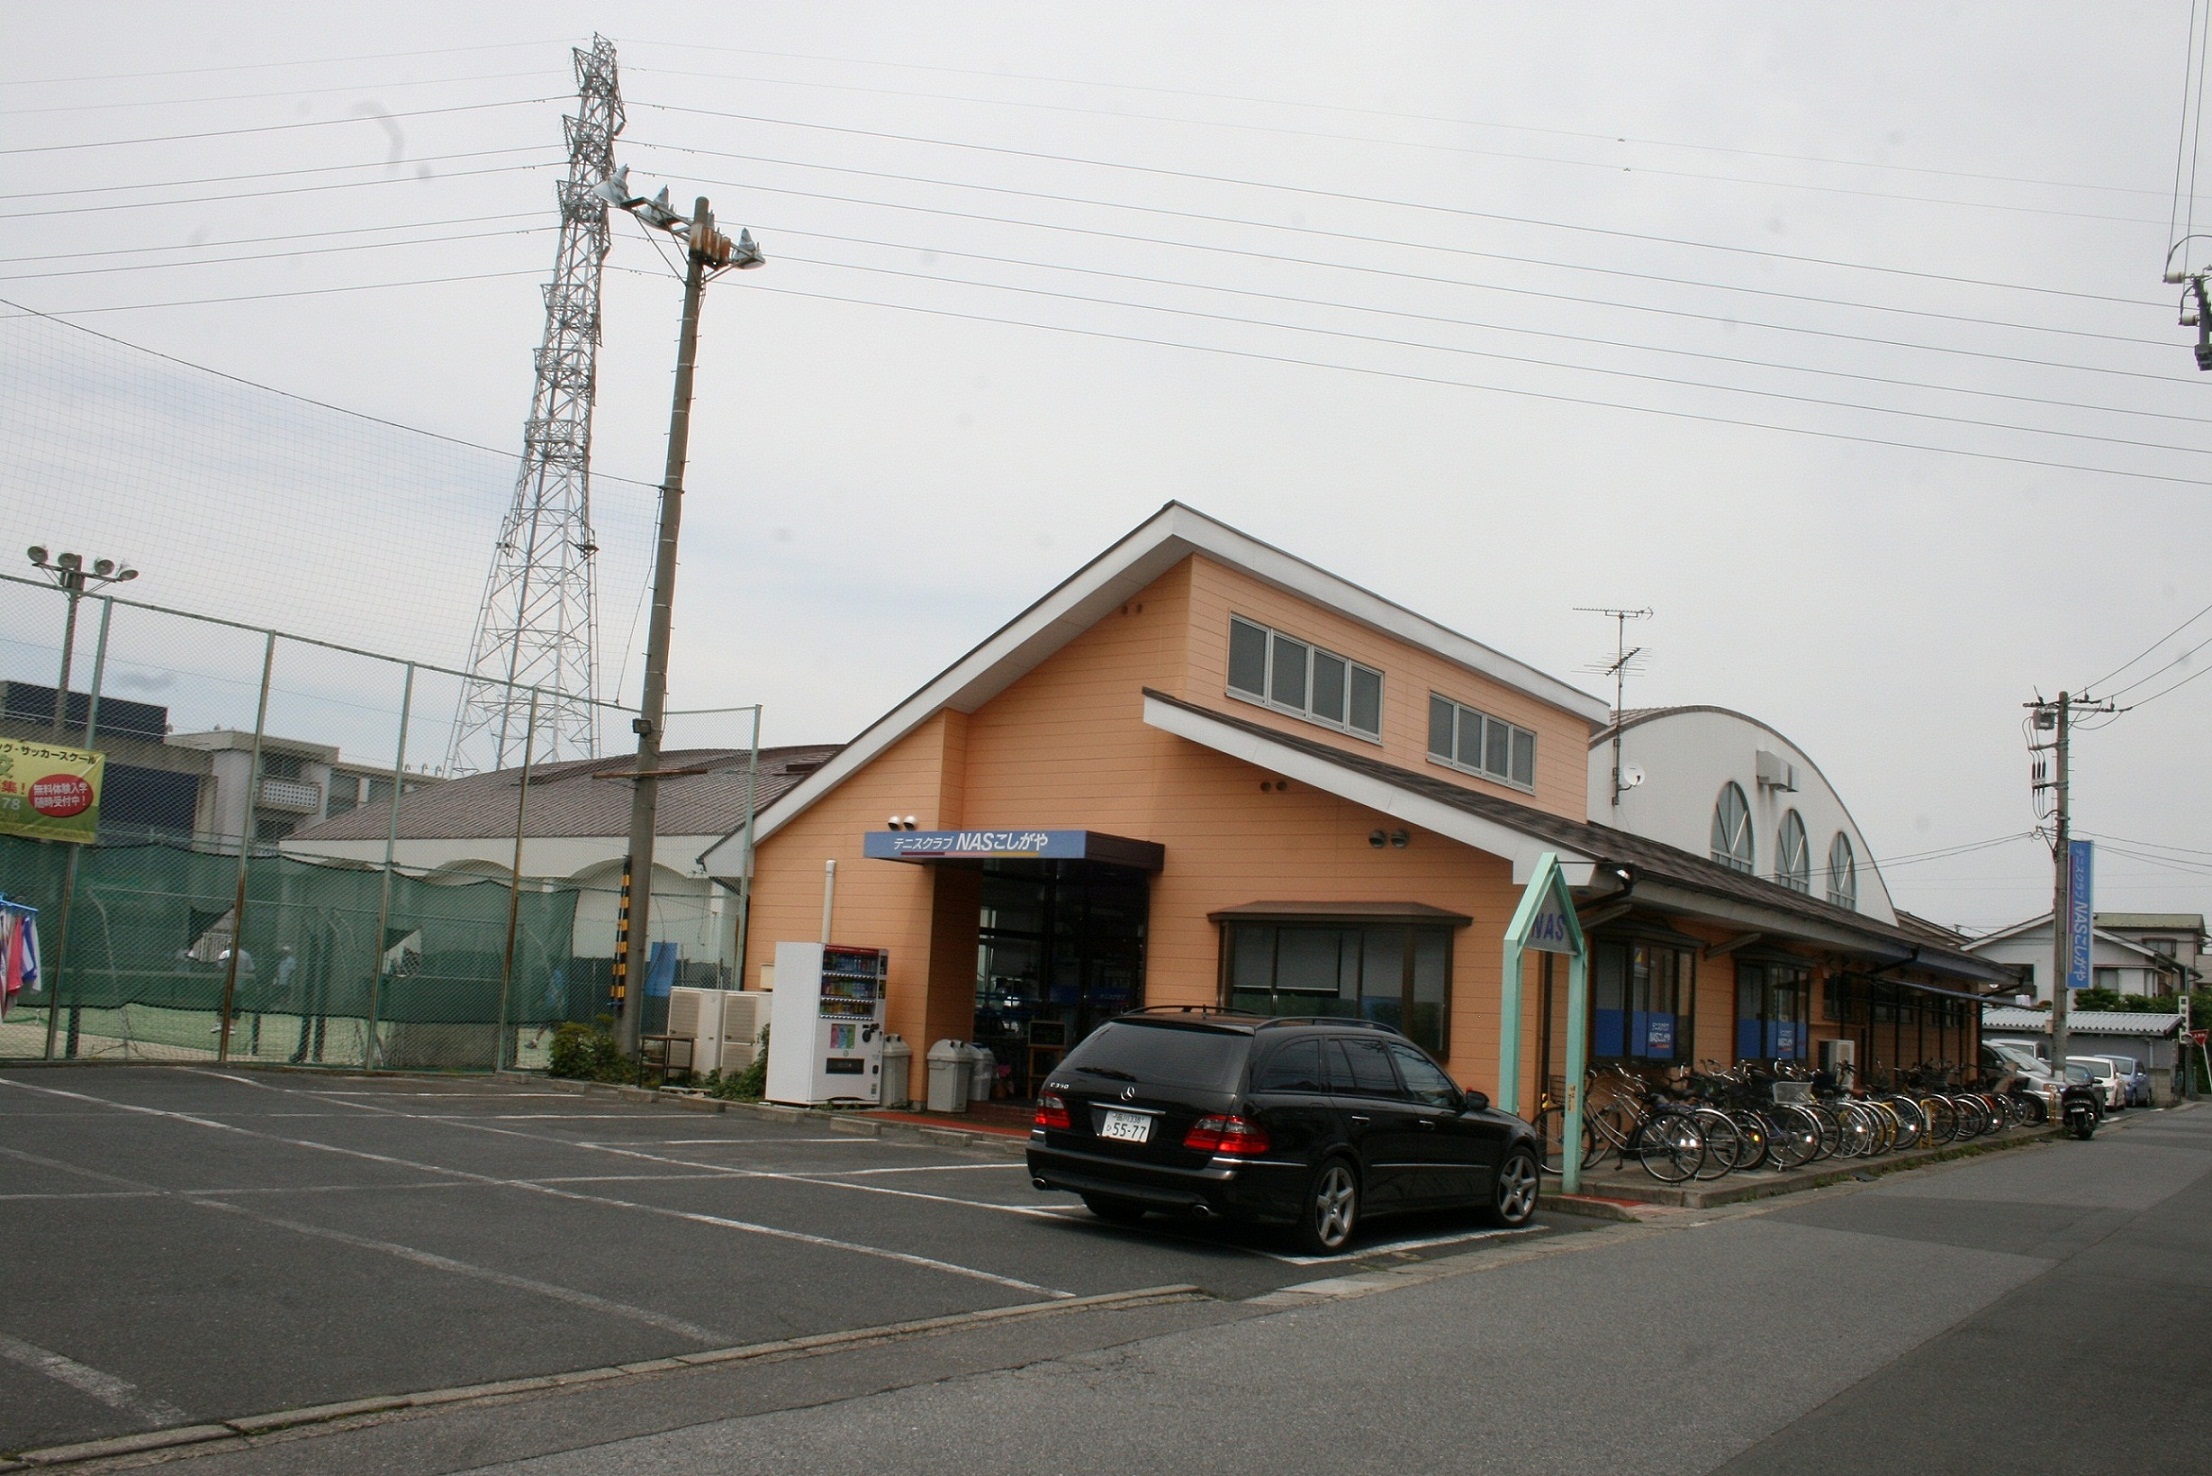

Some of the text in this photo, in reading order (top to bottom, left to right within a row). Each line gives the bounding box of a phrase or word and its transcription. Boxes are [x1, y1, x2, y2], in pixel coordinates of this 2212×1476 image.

[33, 783, 88, 797] 無料体験入学
[894, 836, 954, 850] テニスクラブ
[2075, 848, 2085, 900] テニスクラブ
[1531, 912, 1565, 941] NAS
[1112, 1122, 1146, 1139] 55-77
